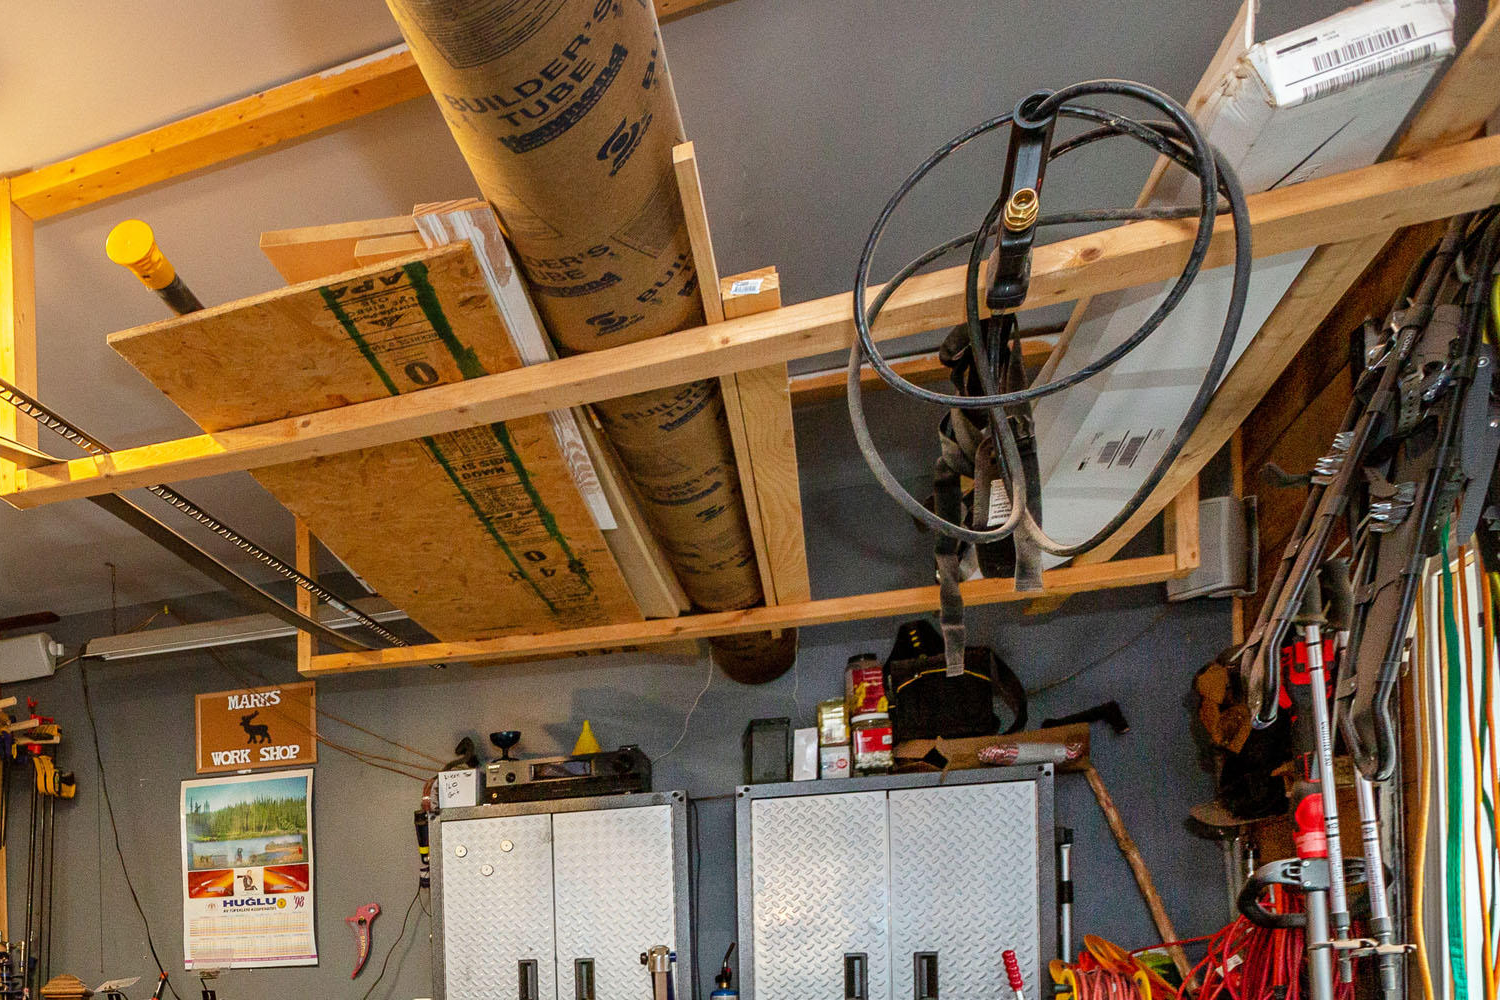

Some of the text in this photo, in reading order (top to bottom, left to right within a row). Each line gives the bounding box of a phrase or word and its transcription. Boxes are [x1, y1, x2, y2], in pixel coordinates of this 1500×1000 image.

[498, 58, 596, 127] TUBE
[404, 361, 440, 386] 0
[227, 690, 281, 710] MARKS
[211, 744, 300, 766] WORK SHOP
[223, 897, 277, 907] HUĞLU
